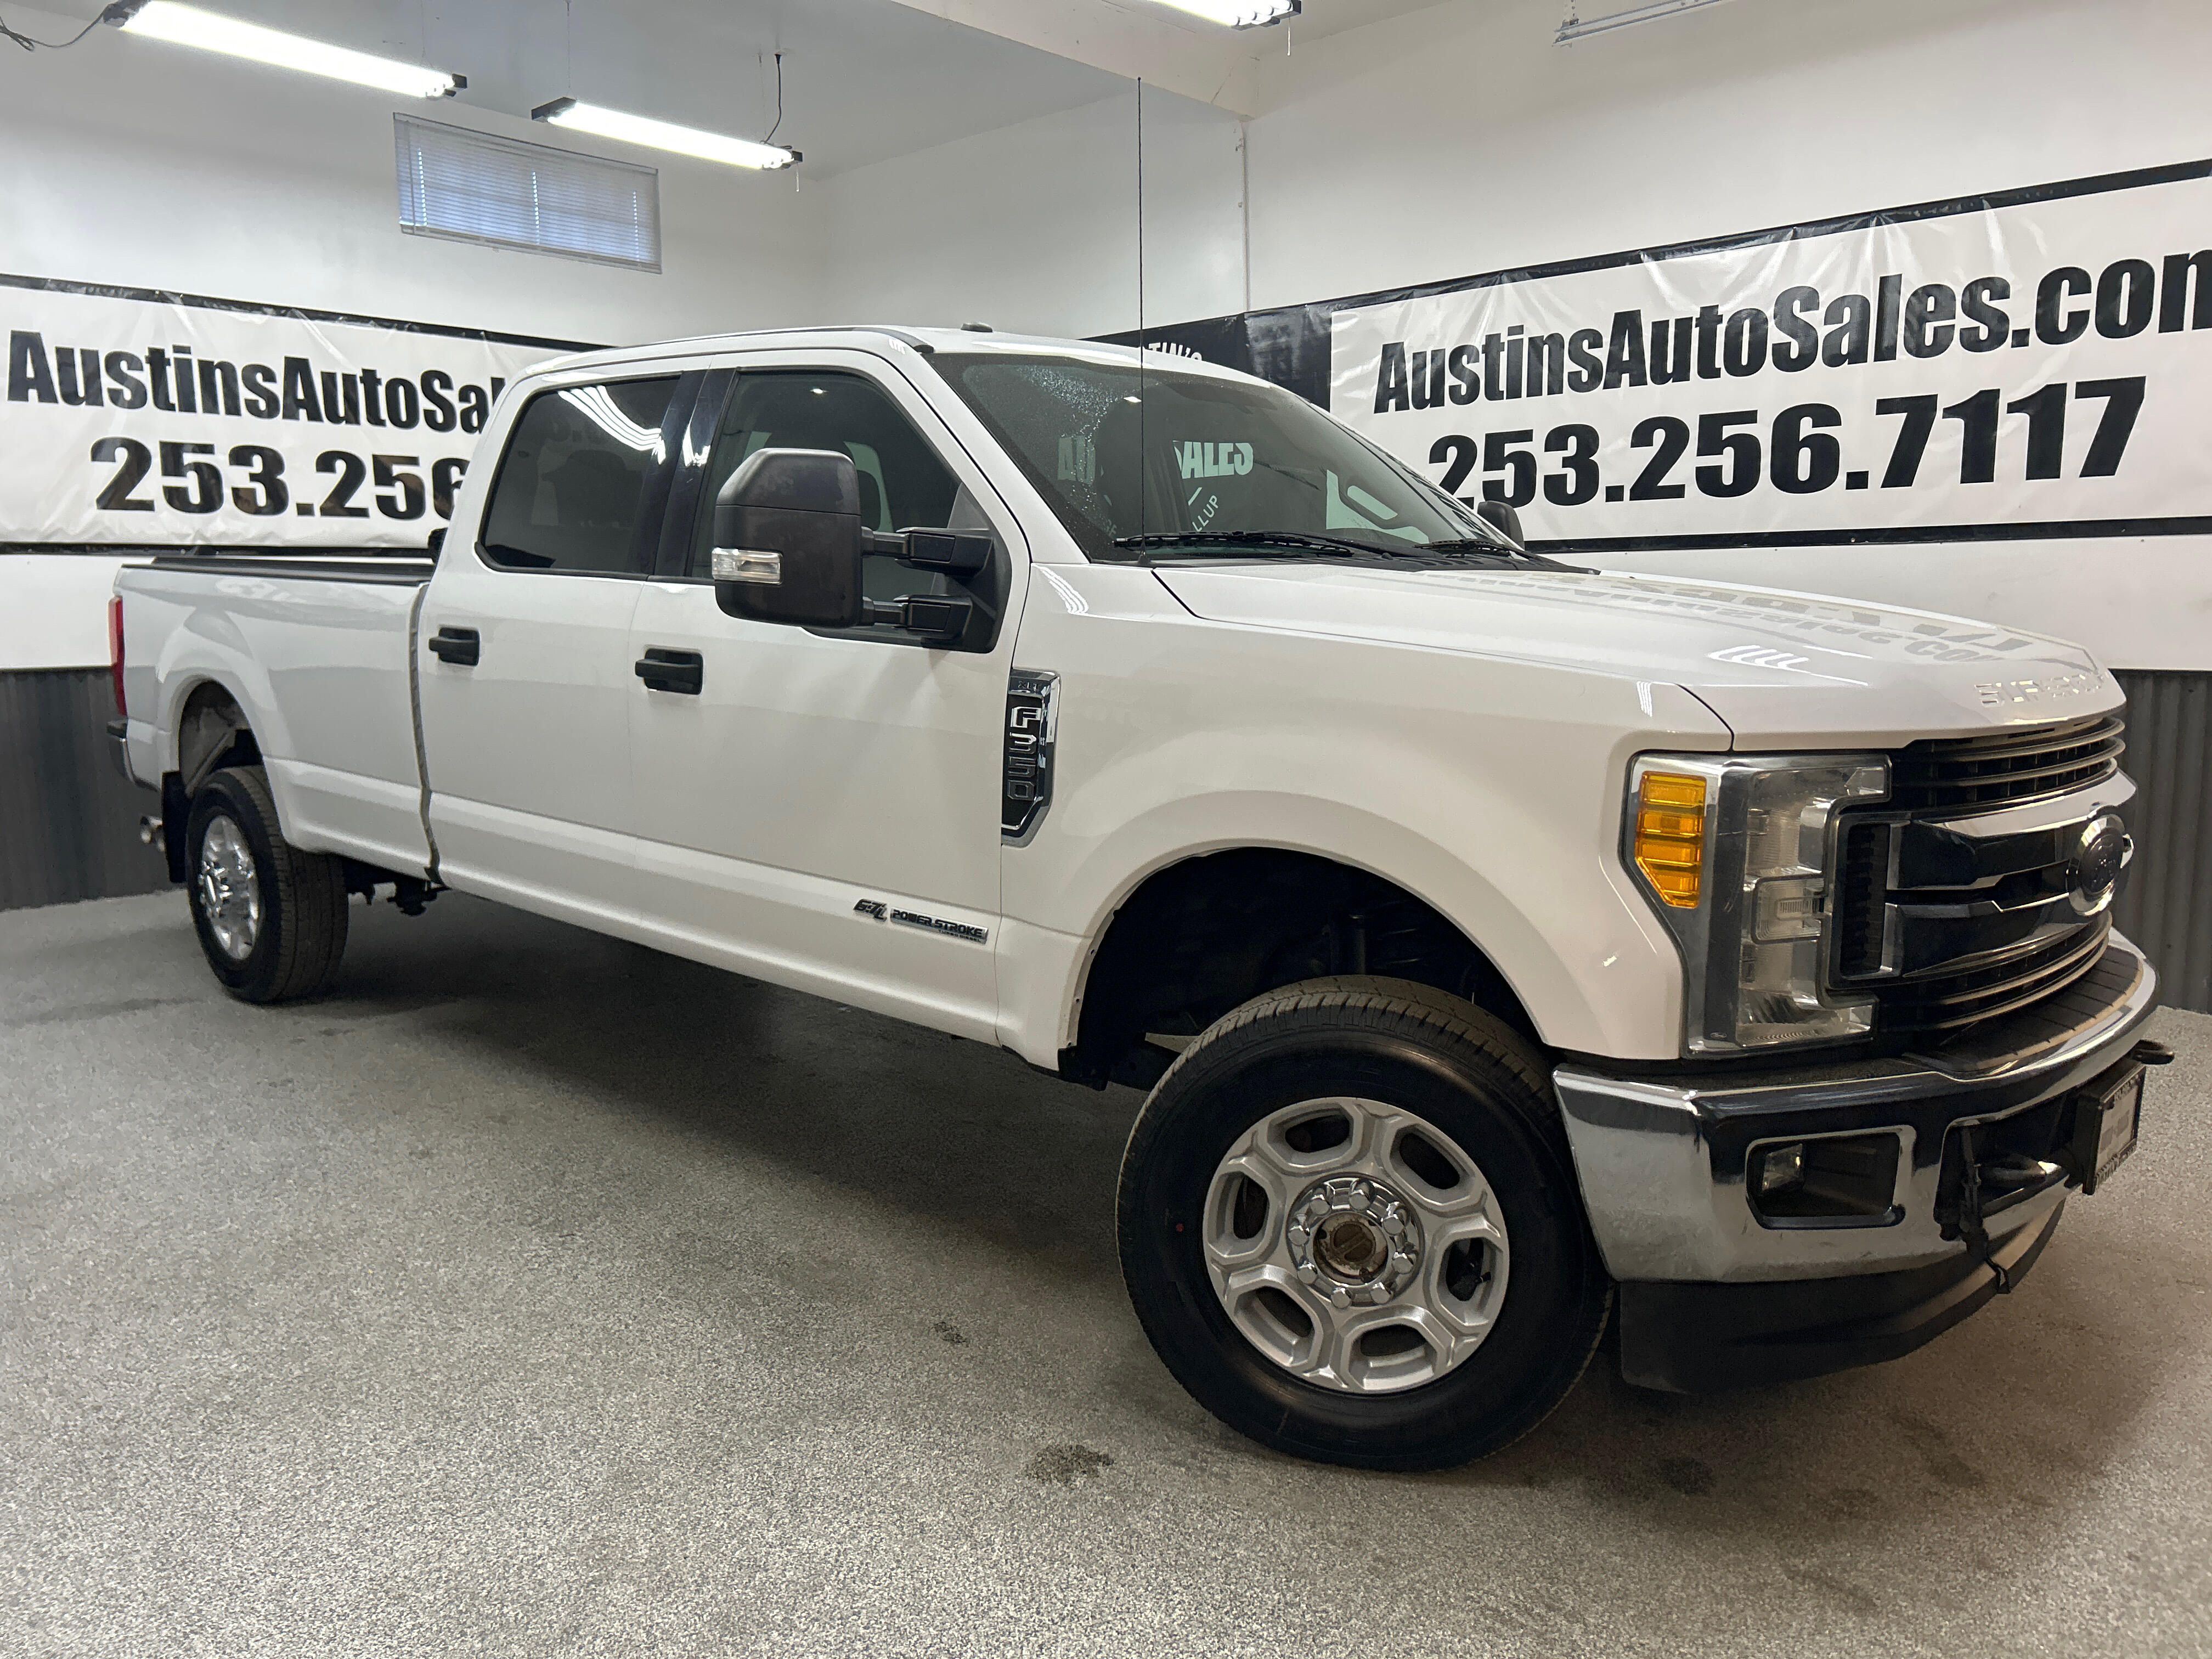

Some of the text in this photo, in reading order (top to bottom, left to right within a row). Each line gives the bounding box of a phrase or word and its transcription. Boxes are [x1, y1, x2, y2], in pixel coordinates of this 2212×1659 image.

[1172, 440, 1254, 479] ALES
[1429, 375, 2147, 510] 253.256.7117
[934, 918, 983, 939] STROKE
